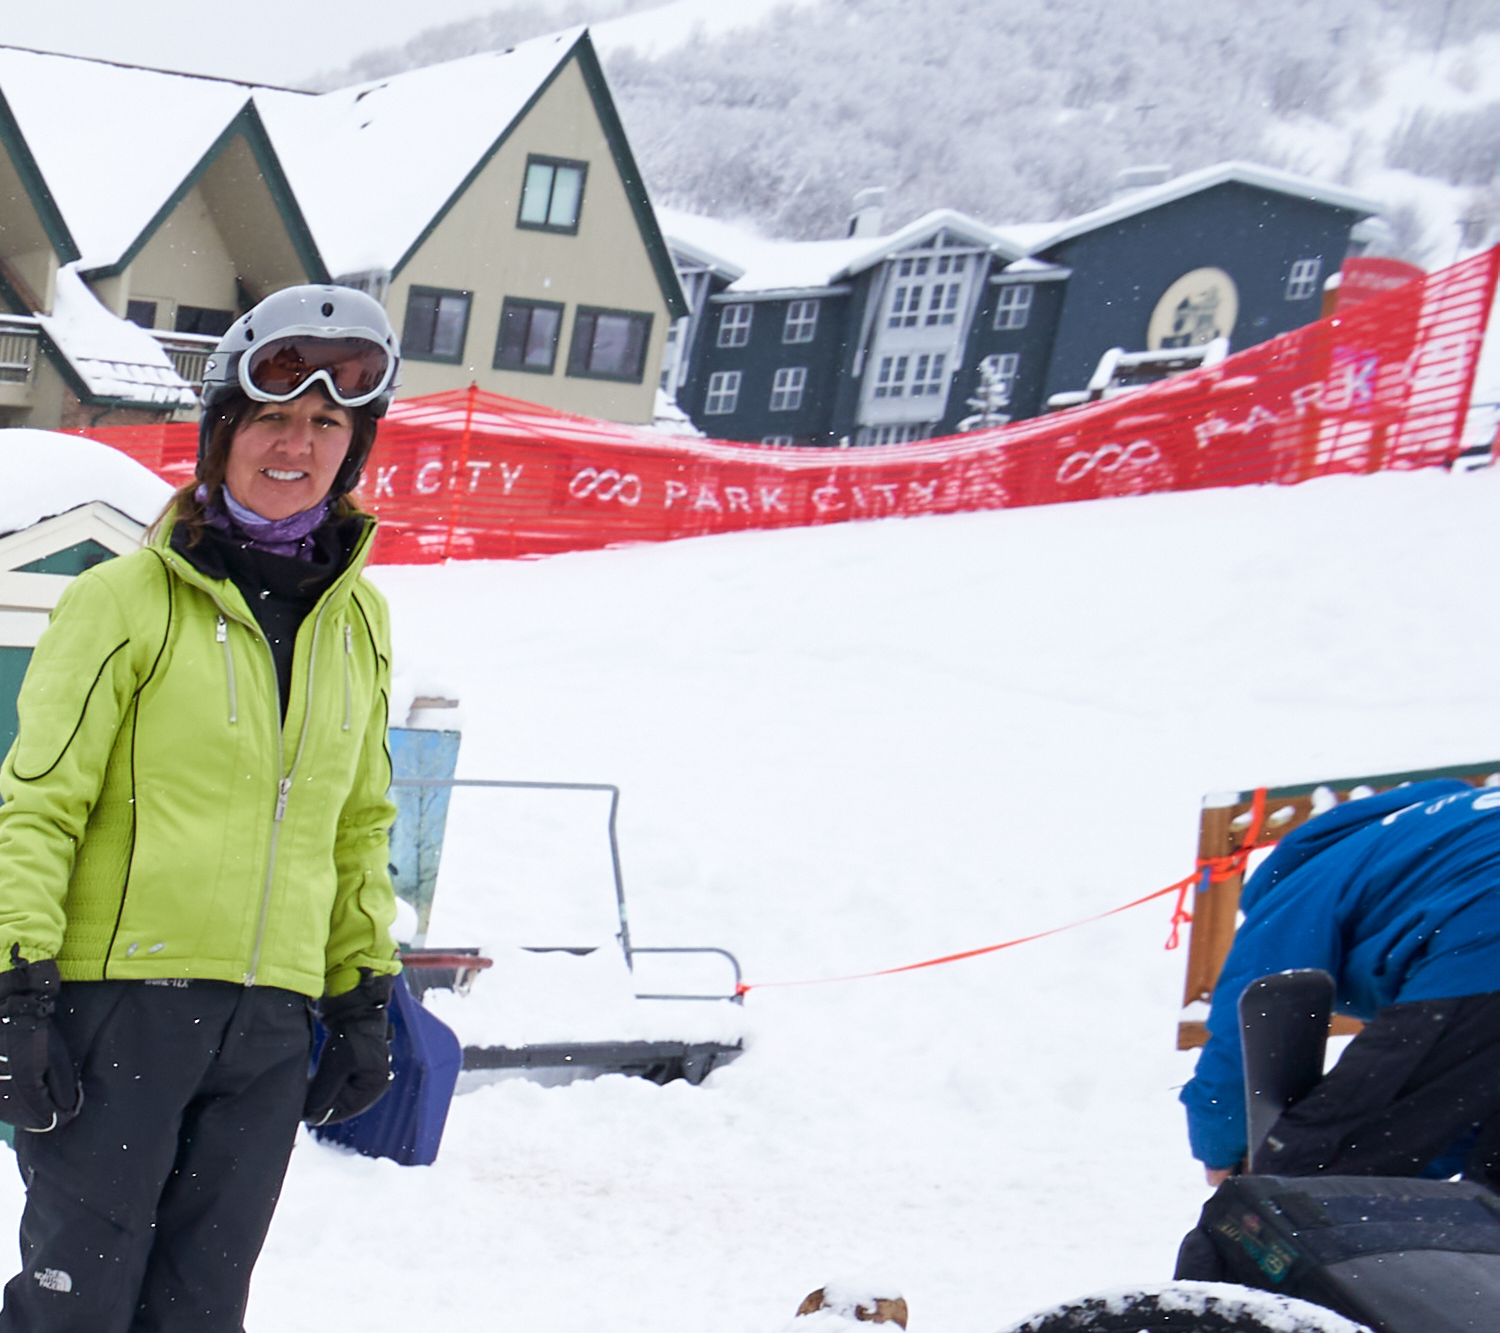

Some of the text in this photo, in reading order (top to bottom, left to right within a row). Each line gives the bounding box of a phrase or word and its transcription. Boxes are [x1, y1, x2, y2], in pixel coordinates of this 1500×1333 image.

[415, 460, 525, 495] CITY
[663, 478, 938, 513] PARK CITY
